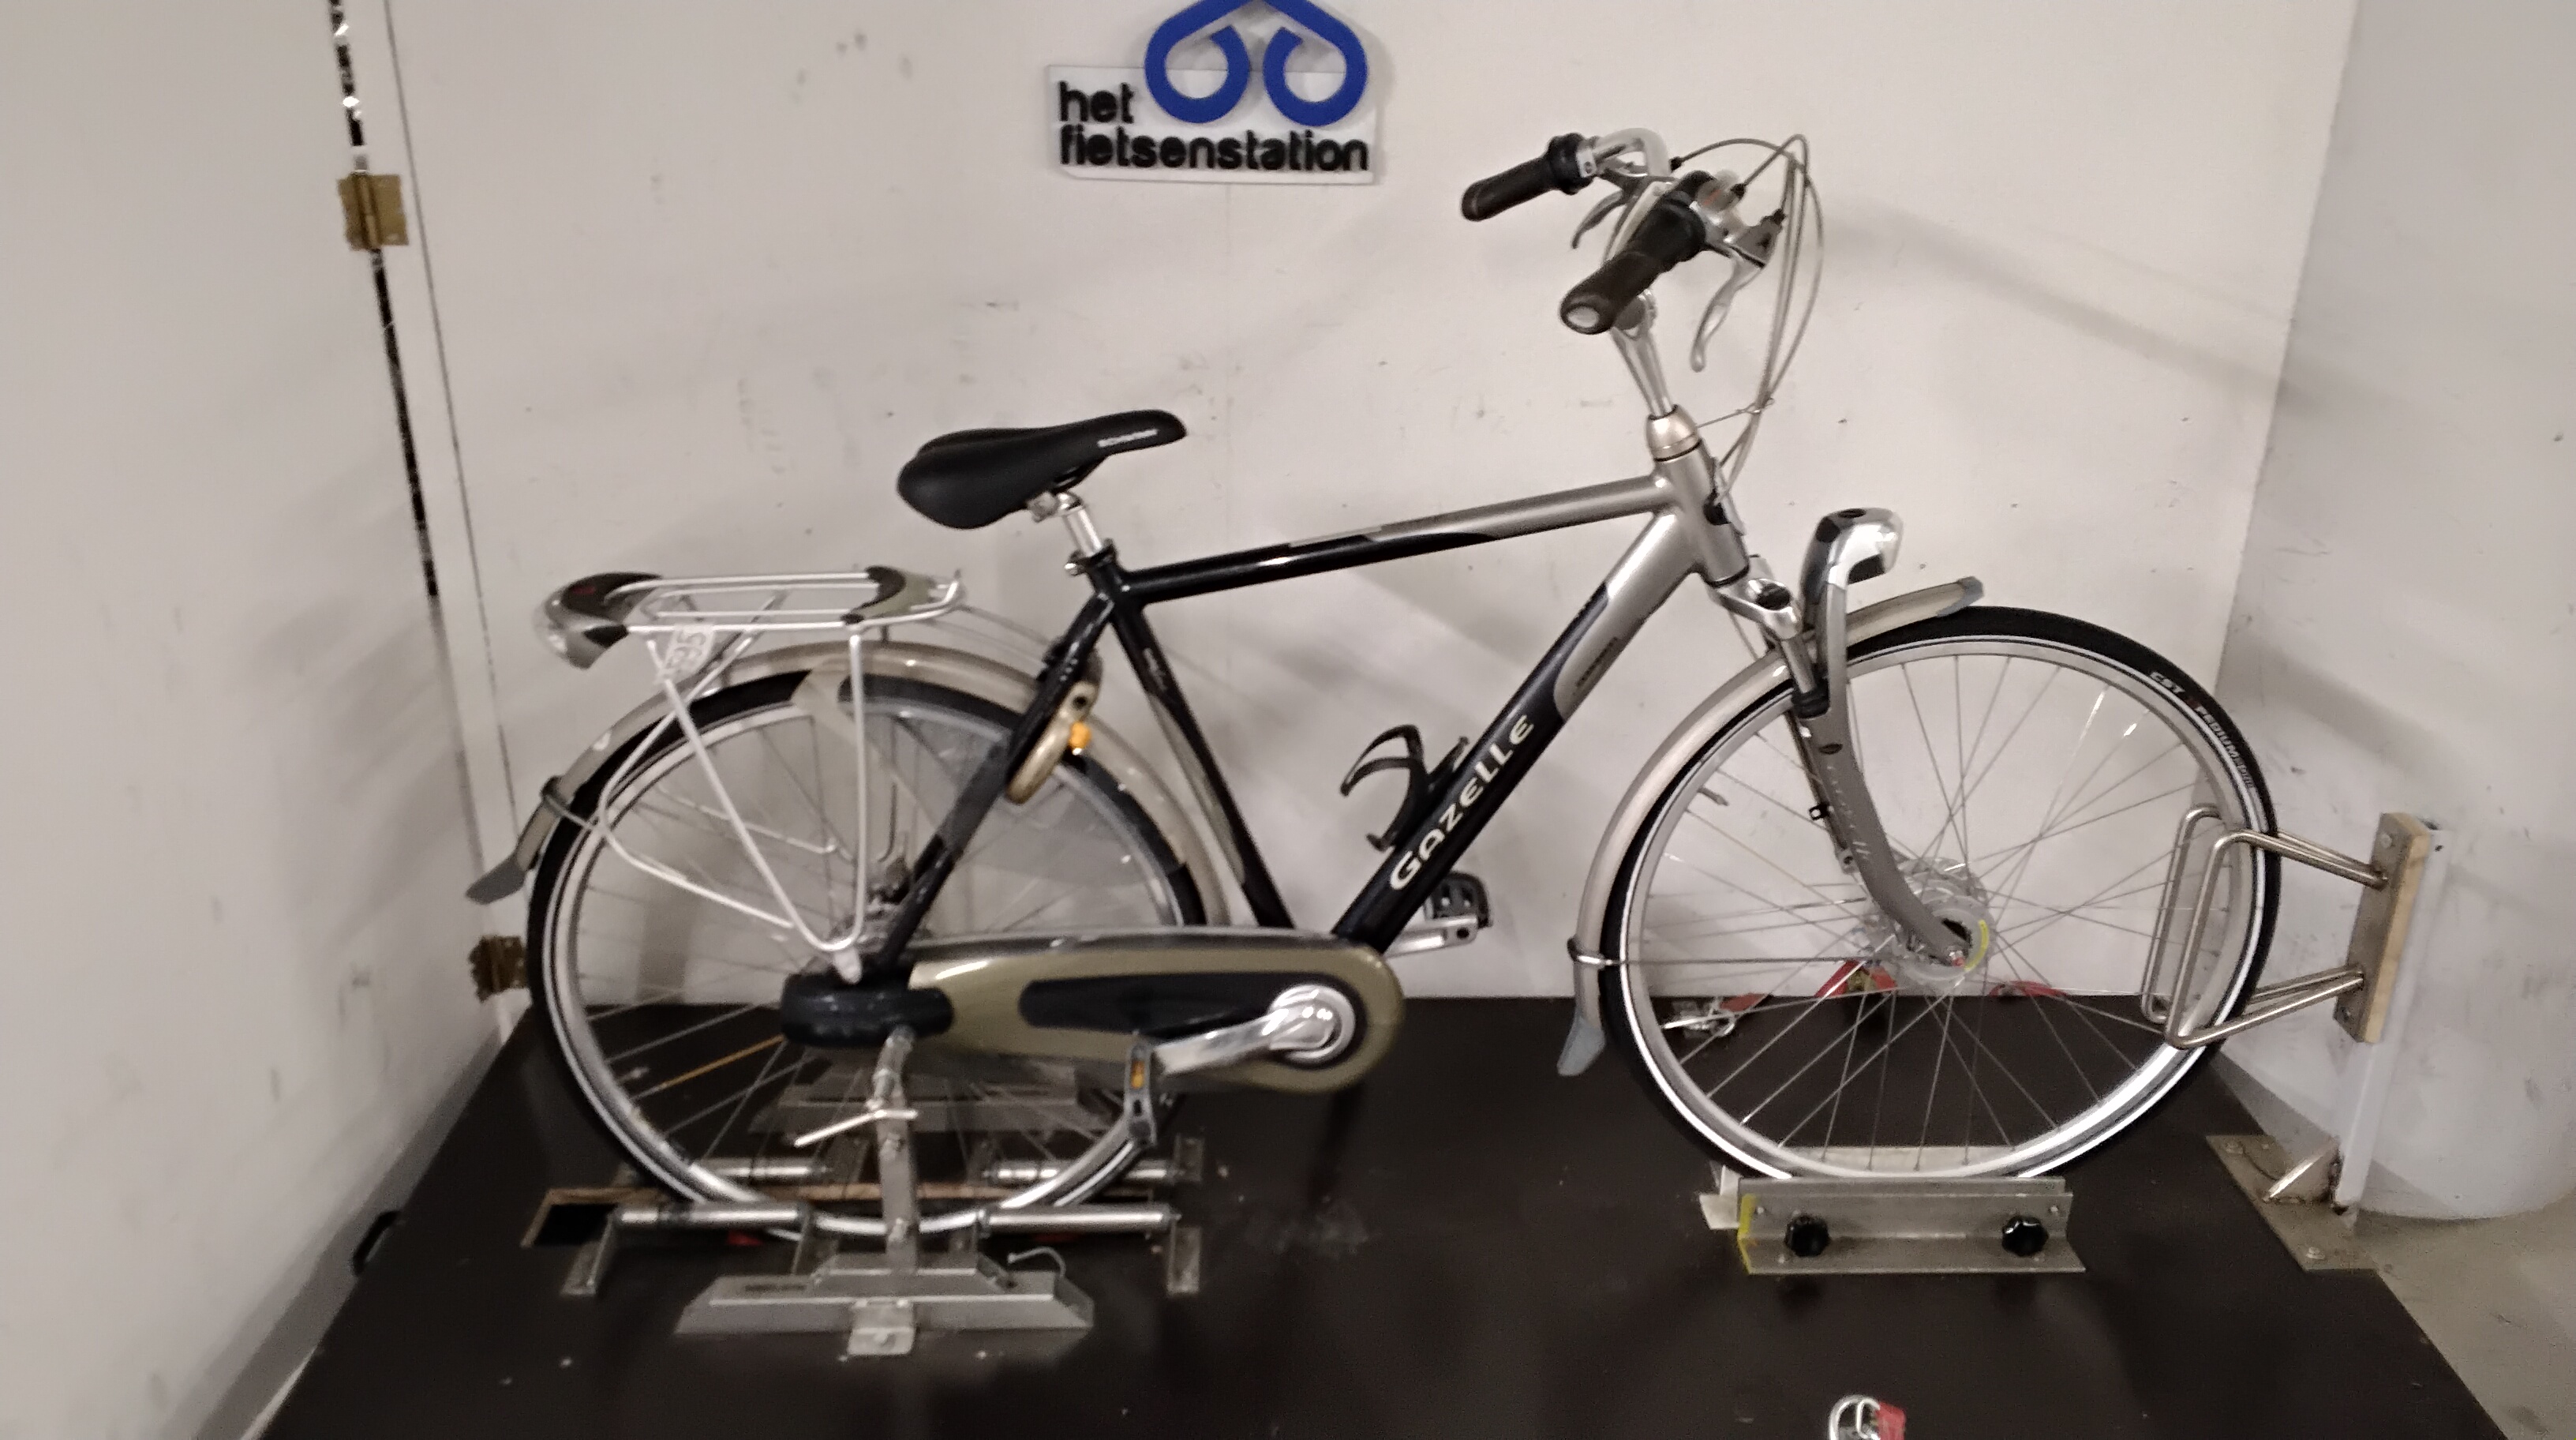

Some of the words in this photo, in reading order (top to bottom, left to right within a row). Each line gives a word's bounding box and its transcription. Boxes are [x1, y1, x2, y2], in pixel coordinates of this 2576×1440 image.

[1059, 81, 1134, 123] het
[1060, 124, 1369, 171] fietsenstation
[1389, 714, 1534, 891] GAZELLE
